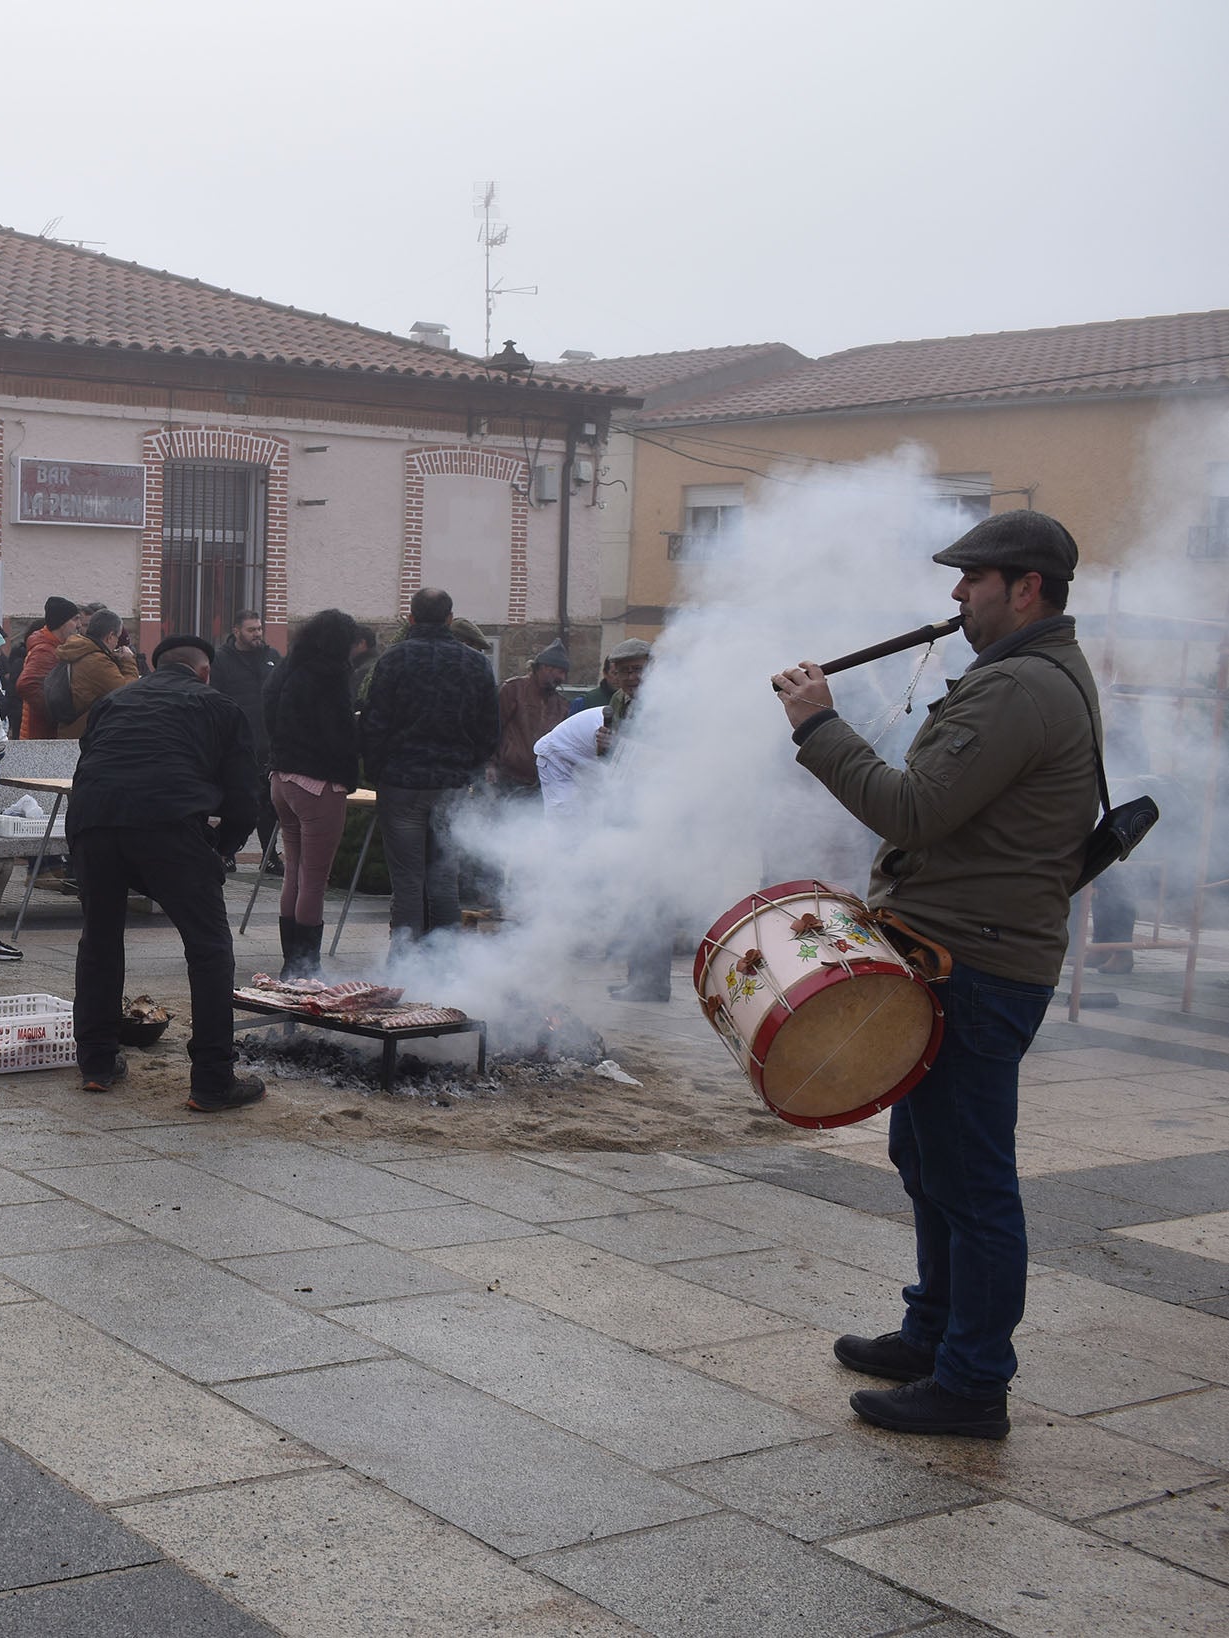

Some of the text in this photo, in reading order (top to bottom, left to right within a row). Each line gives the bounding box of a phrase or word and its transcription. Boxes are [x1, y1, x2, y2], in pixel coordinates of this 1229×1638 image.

[37, 464, 70, 486] BAR
[23, 492, 43, 517] LA
[17, 1026, 46, 1041] MAGUISA
